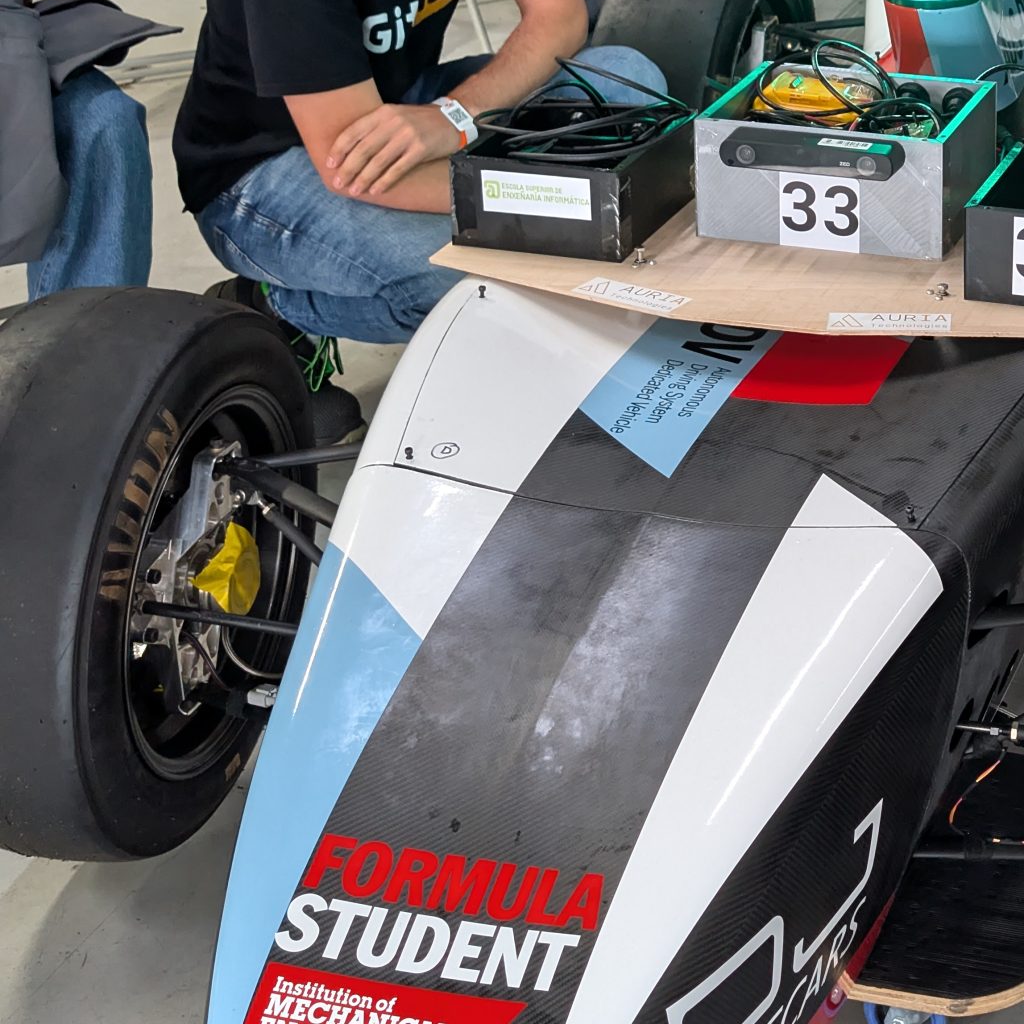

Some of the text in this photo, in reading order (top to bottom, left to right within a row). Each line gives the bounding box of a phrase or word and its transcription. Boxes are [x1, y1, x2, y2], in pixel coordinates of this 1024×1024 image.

[501, 182, 524, 191] ESCOLA
[782, 180, 859, 237] 33
[619, 286, 686, 305] AURIA
[871, 314, 947, 322] AURIA
[610, 359, 684, 434] Dedicated Vehicle
[645, 363, 708, 424] Driving System
[677, 366, 732, 418] Autonomous
[301, 833, 605, 931] FORMULA
[274, 893, 581, 992] STUDENT
[273, 976, 398, 1013] Institution of
